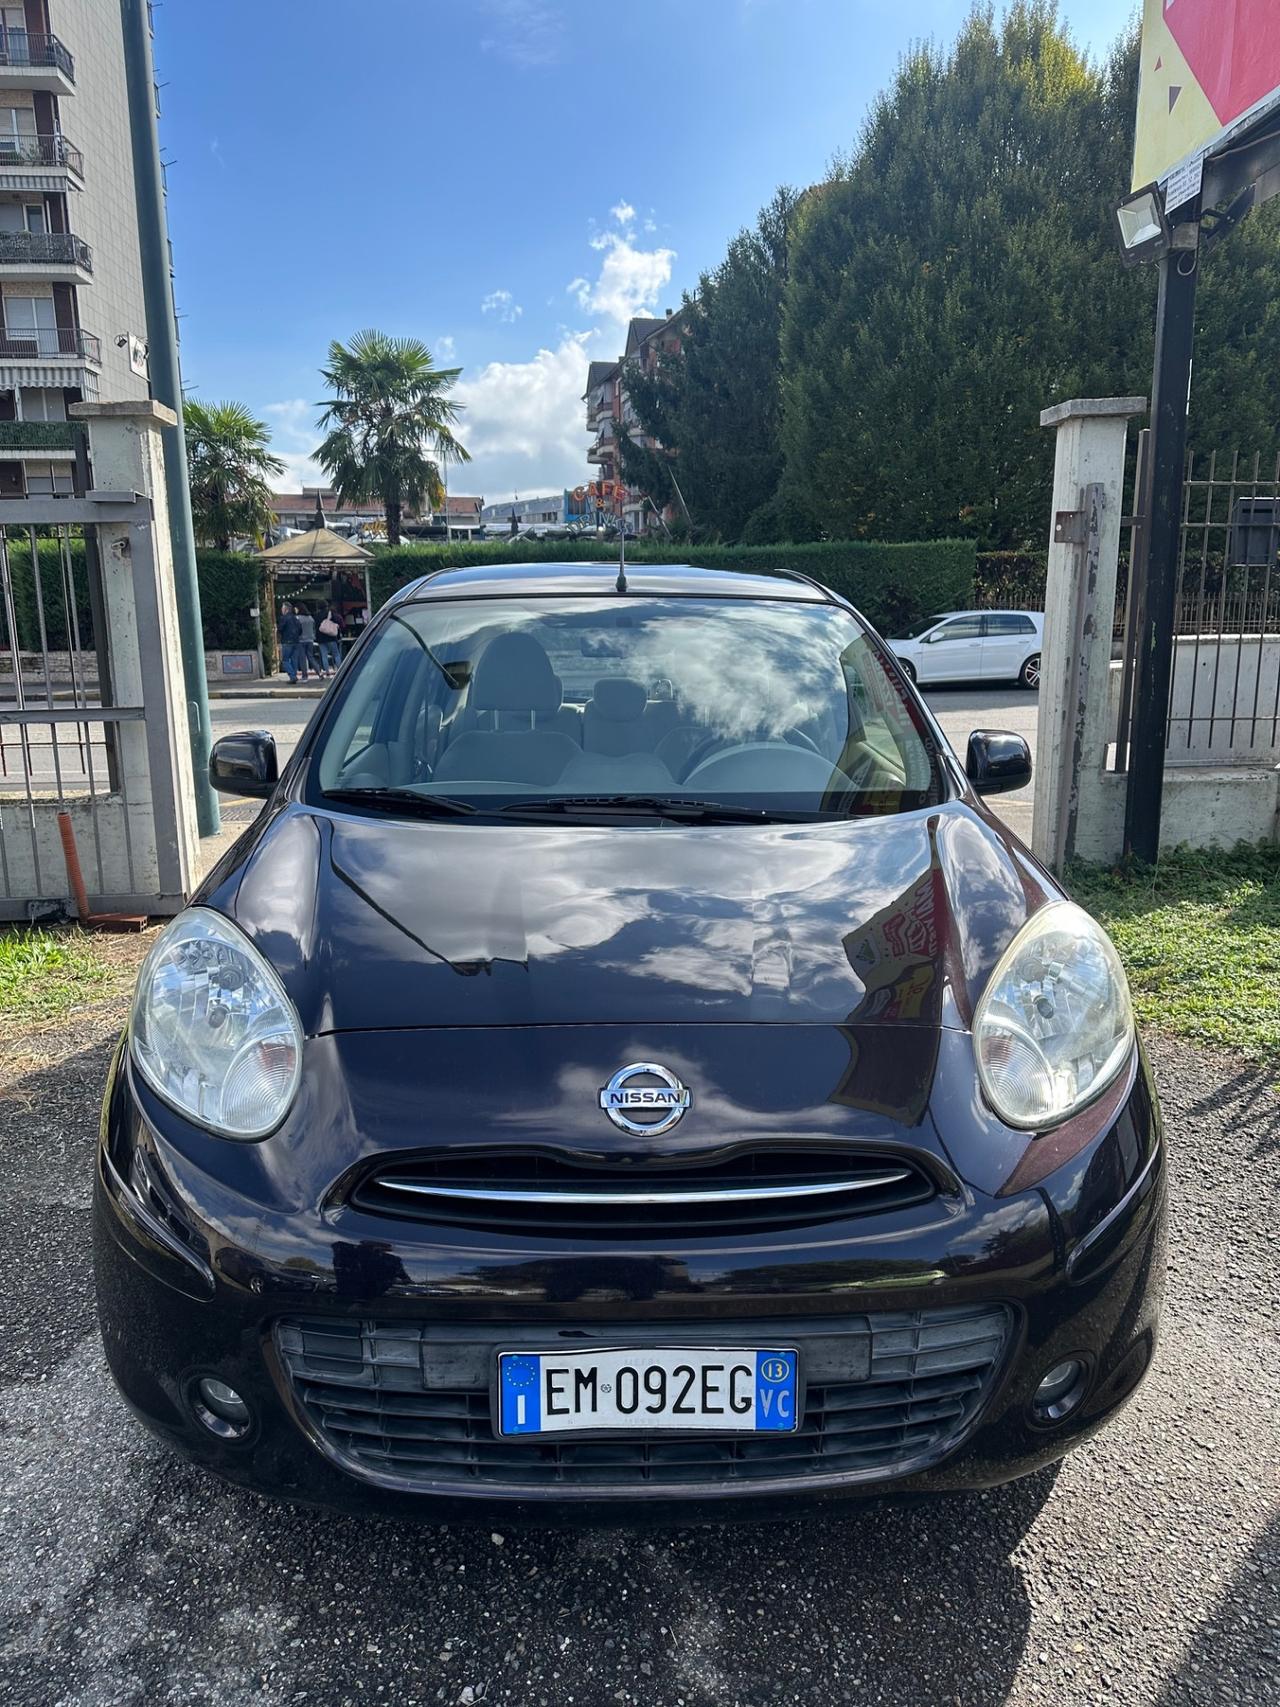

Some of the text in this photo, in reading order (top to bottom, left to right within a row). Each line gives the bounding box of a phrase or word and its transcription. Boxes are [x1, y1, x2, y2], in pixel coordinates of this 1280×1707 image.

[610, 1092, 681, 1104] NISSAN
[768, 1362, 784, 1379] 13
[546, 1364, 753, 1416] EM 092EG
[760, 1388, 790, 1418] VC
